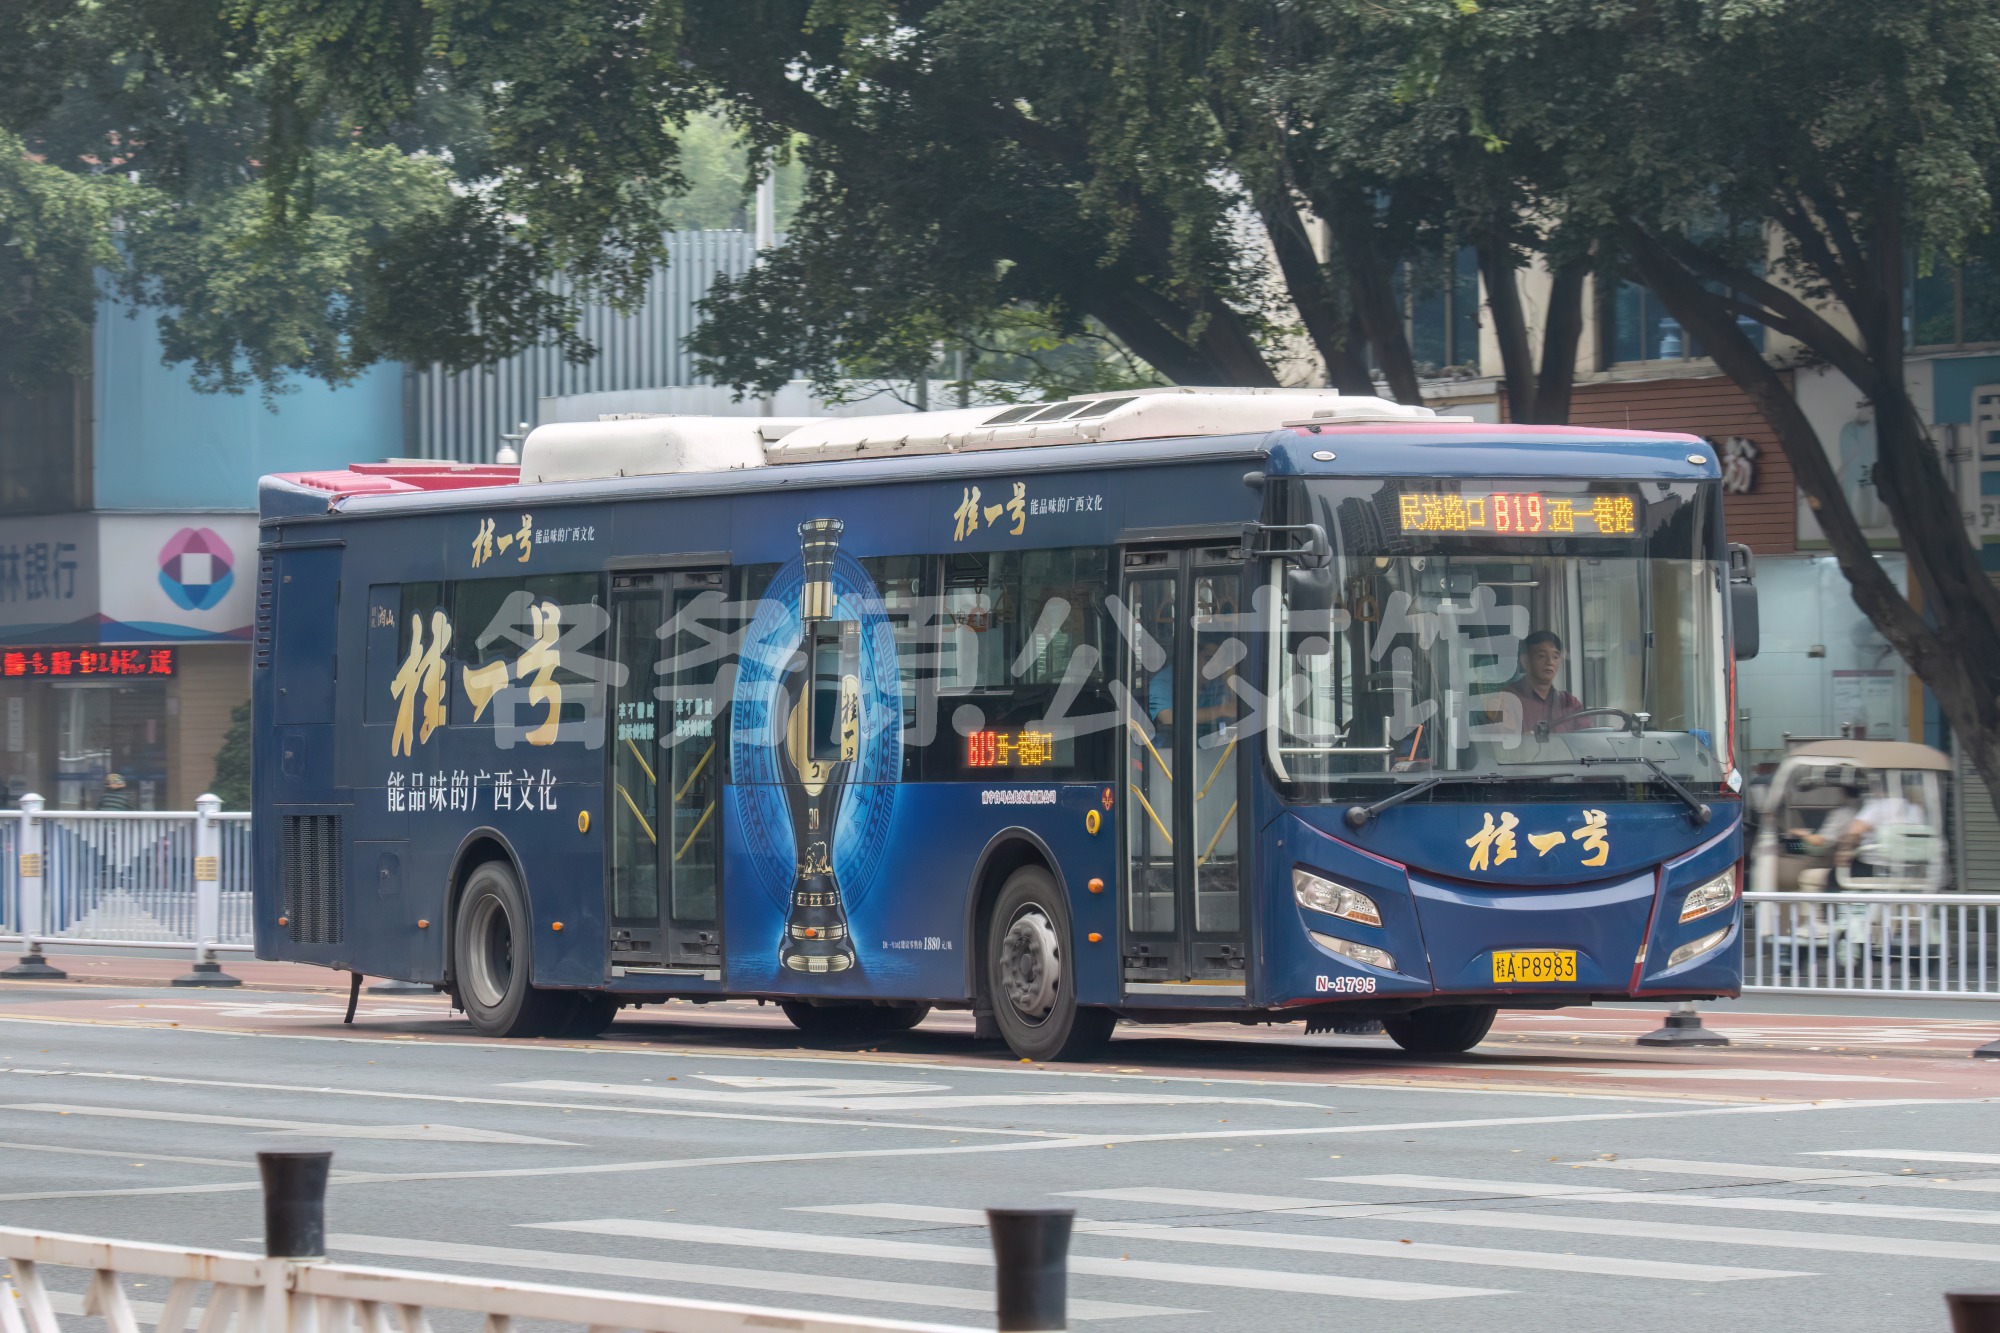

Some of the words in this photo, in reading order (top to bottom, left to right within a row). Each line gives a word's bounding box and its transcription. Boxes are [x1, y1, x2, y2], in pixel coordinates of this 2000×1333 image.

[953, 481, 1026, 542] 桂一号
[1030, 495, 1103, 515] 能品味的广西文化
[1401, 494, 1486, 531] 民族路口
[1493, 494, 1542, 533] B19
[472, 514, 533, 568] 桂一号
[535, 526, 595, 544] 能品味的广西文化
[390, 600, 562, 757] 桂一号
[969, 731, 995, 766] B19
[387, 768, 558, 812] 能品味的广西文化
[808, 808, 820, 830] 30
[1465, 809, 1610, 871] 桂一号
[1316, 976, 1376, 994] N-1795
